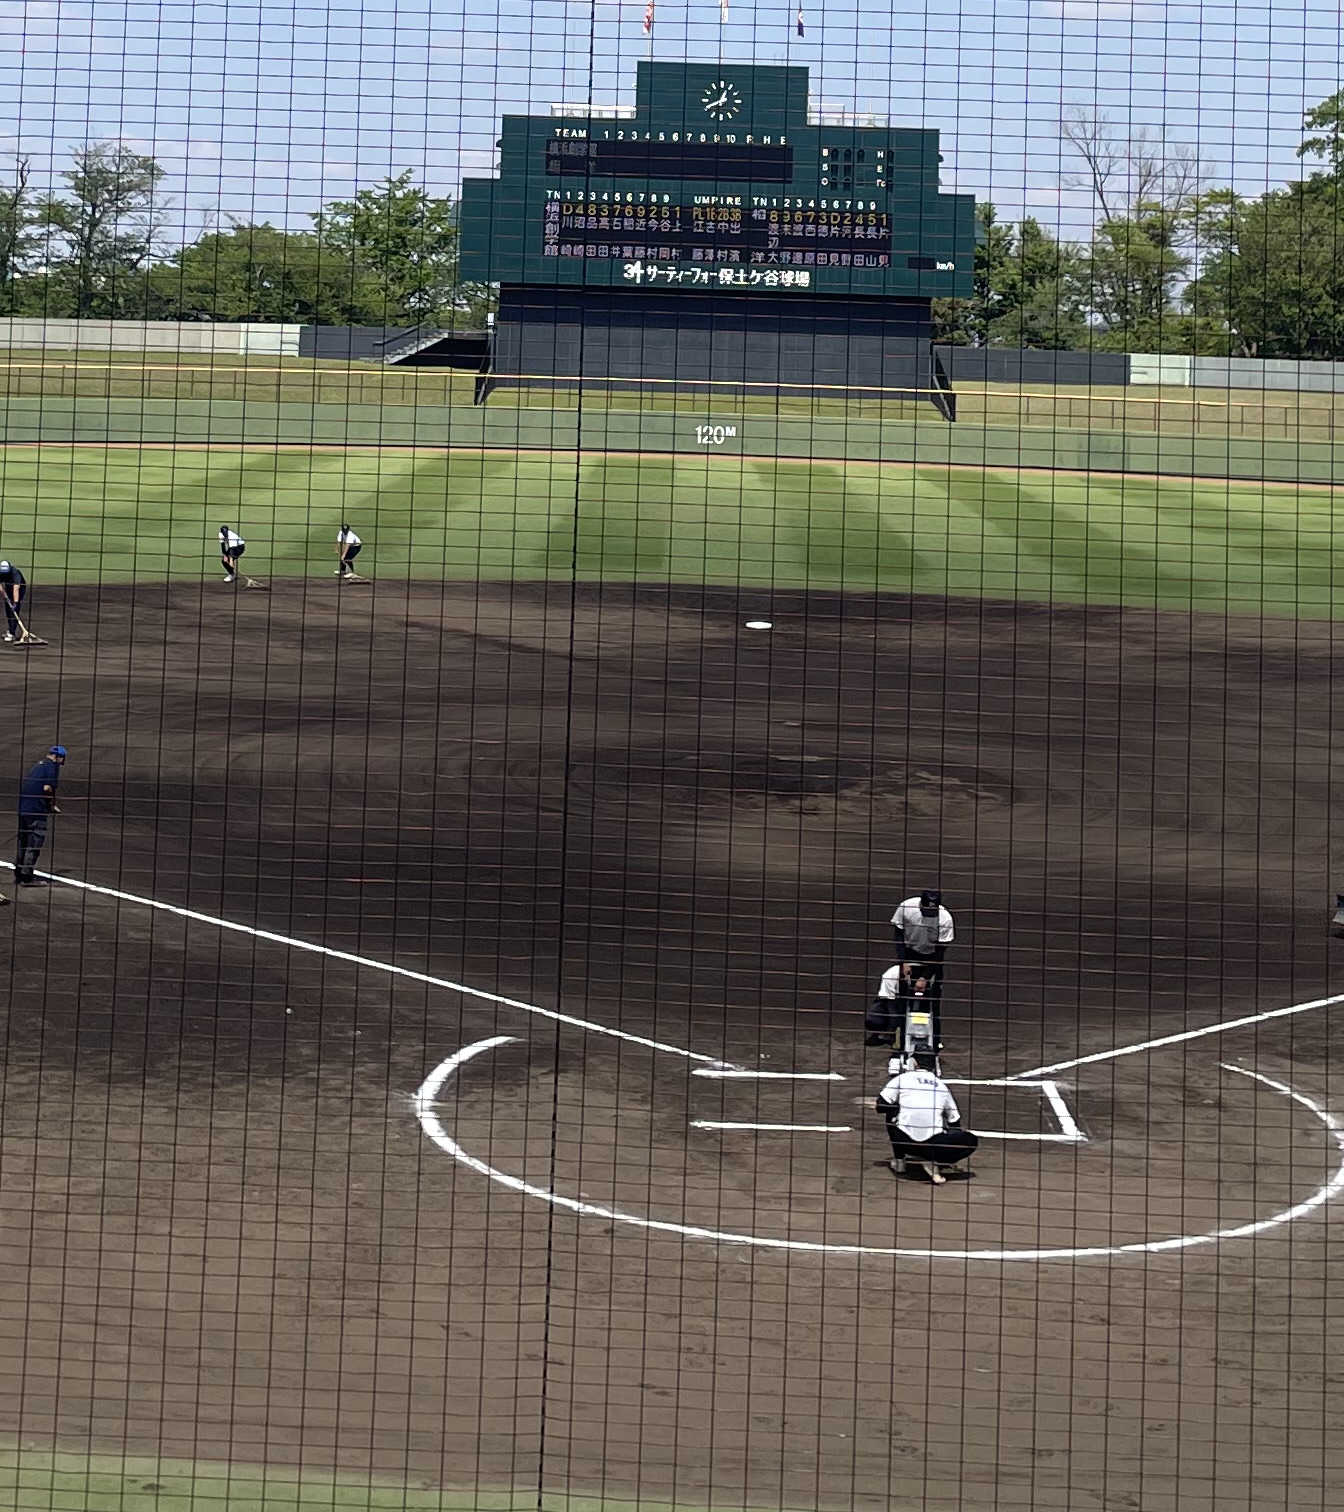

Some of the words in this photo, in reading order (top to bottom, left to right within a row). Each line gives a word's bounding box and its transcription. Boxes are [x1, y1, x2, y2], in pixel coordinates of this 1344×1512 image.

[555, 128, 587, 138] TEAM
[546, 190, 560, 199] TN
[694, 196, 742, 206] UMPIRE
[753, 197, 768, 206] TN
[692, 207, 704, 220] PL
